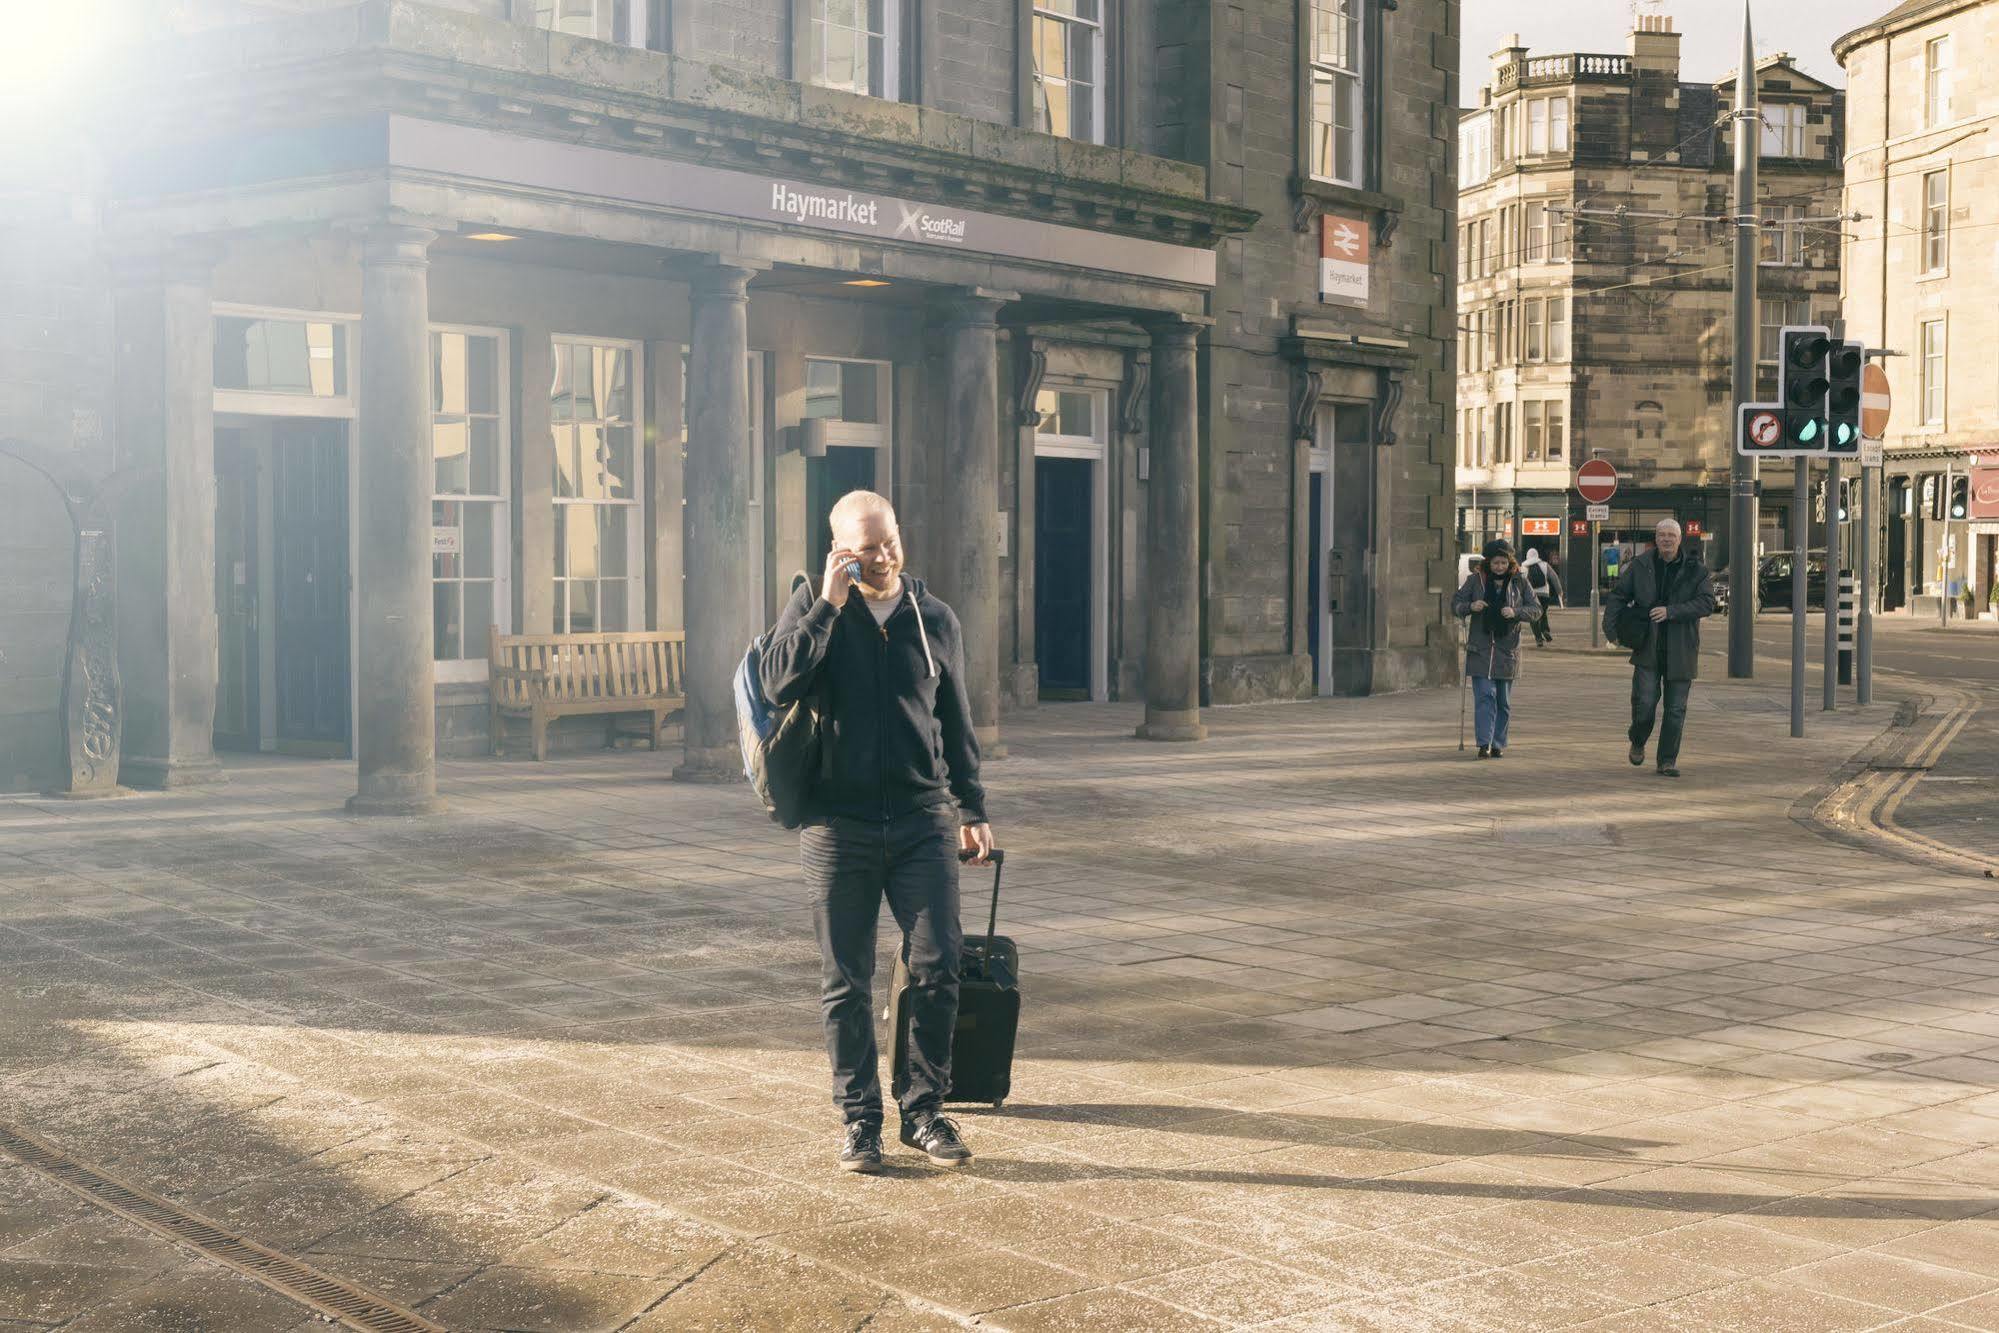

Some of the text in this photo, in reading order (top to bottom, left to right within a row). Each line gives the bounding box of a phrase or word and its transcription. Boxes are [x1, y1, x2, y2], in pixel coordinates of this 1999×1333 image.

[772, 183, 878, 225] Haymarket
[921, 215, 965, 236] ScotRail
[1329, 270, 1362, 285] Haymarket
